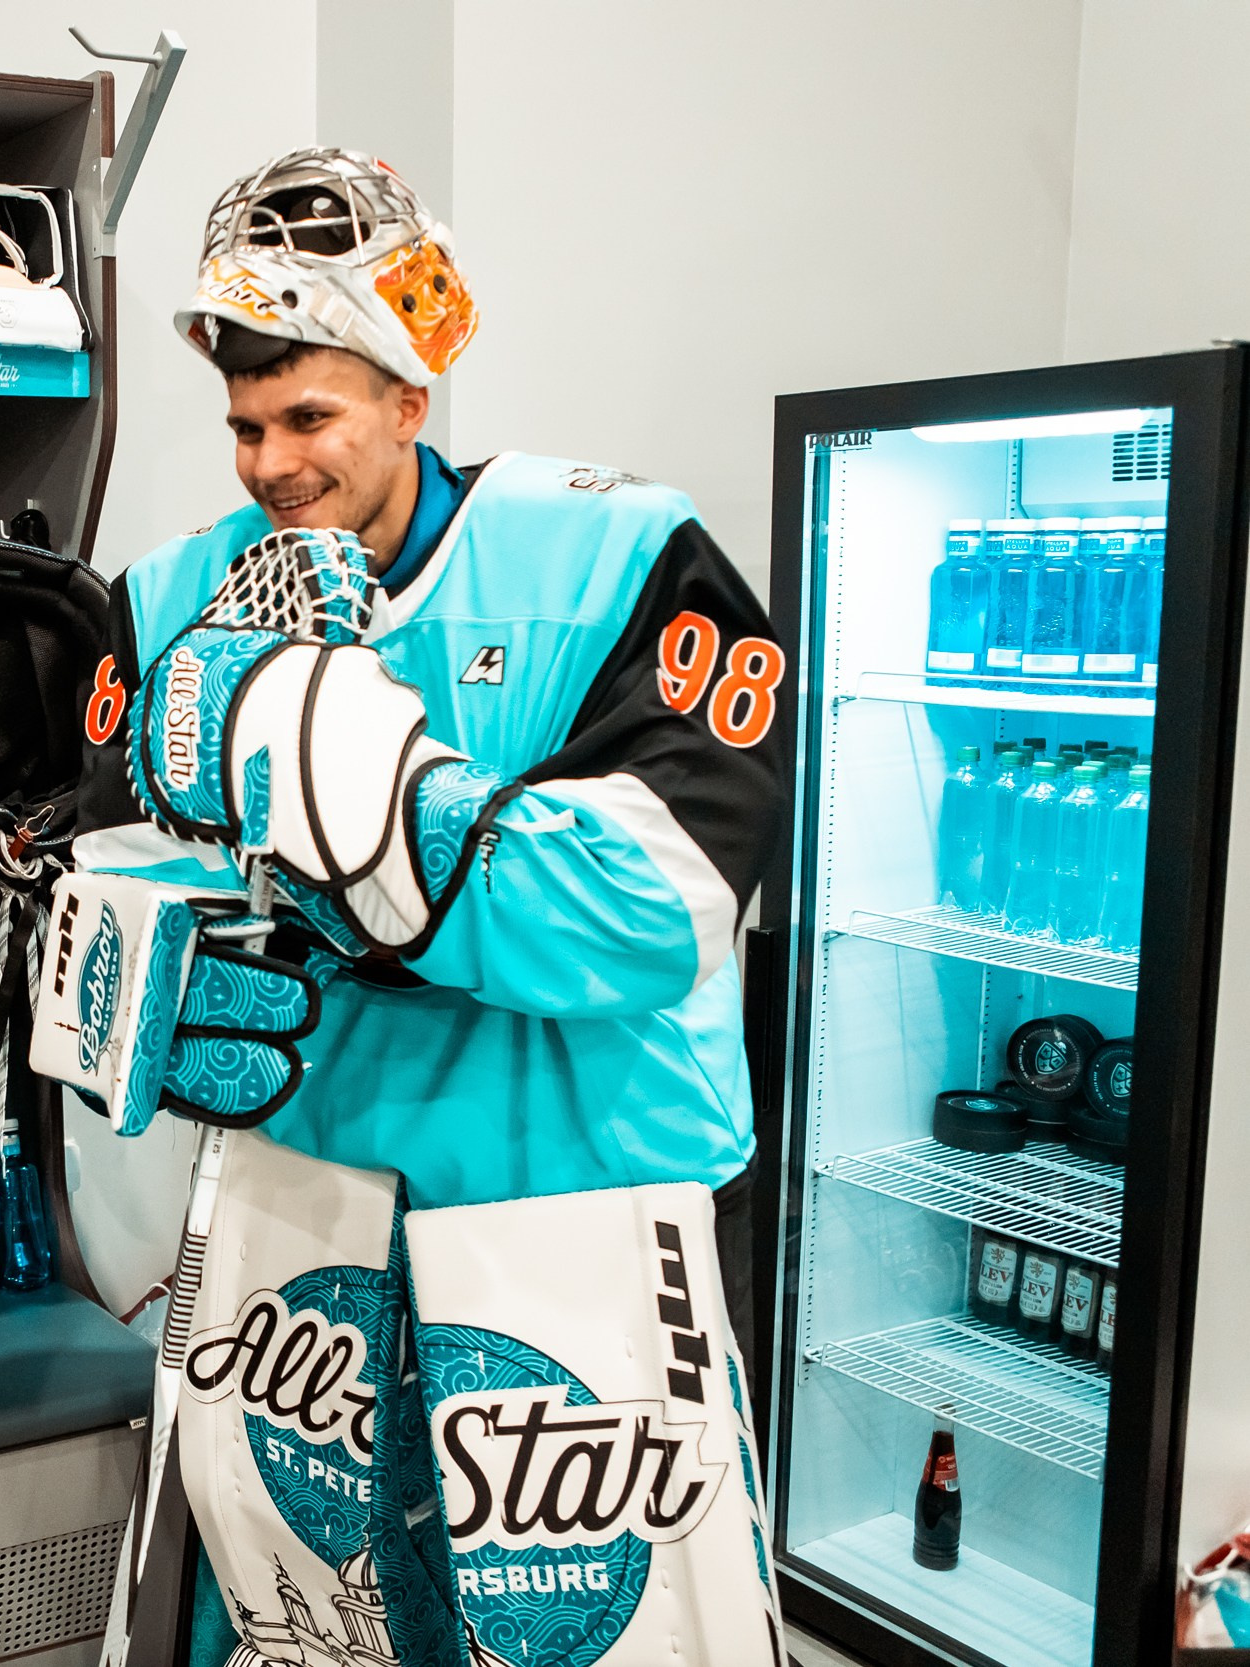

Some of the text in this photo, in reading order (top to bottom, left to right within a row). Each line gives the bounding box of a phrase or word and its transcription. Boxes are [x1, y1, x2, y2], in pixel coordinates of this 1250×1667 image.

[809, 431, 873, 449] POLAIR
[85, 653, 127, 746] 8
[657, 610, 786, 749] 98
[166, 649, 200, 787] All-Star
[80, 909, 114, 1068] Bobrov
[103, 951, 118, 1031] DIVISION
[980, 1262, 1014, 1283] LEV
[1021, 1278, 1053, 1298] LEV
[1063, 1293, 1090, 1312] EV
[266, 1437, 373, 1503] ST. PETE
[443, 1400, 707, 1539] Star
[456, 1561, 610, 1596] RSBURG
